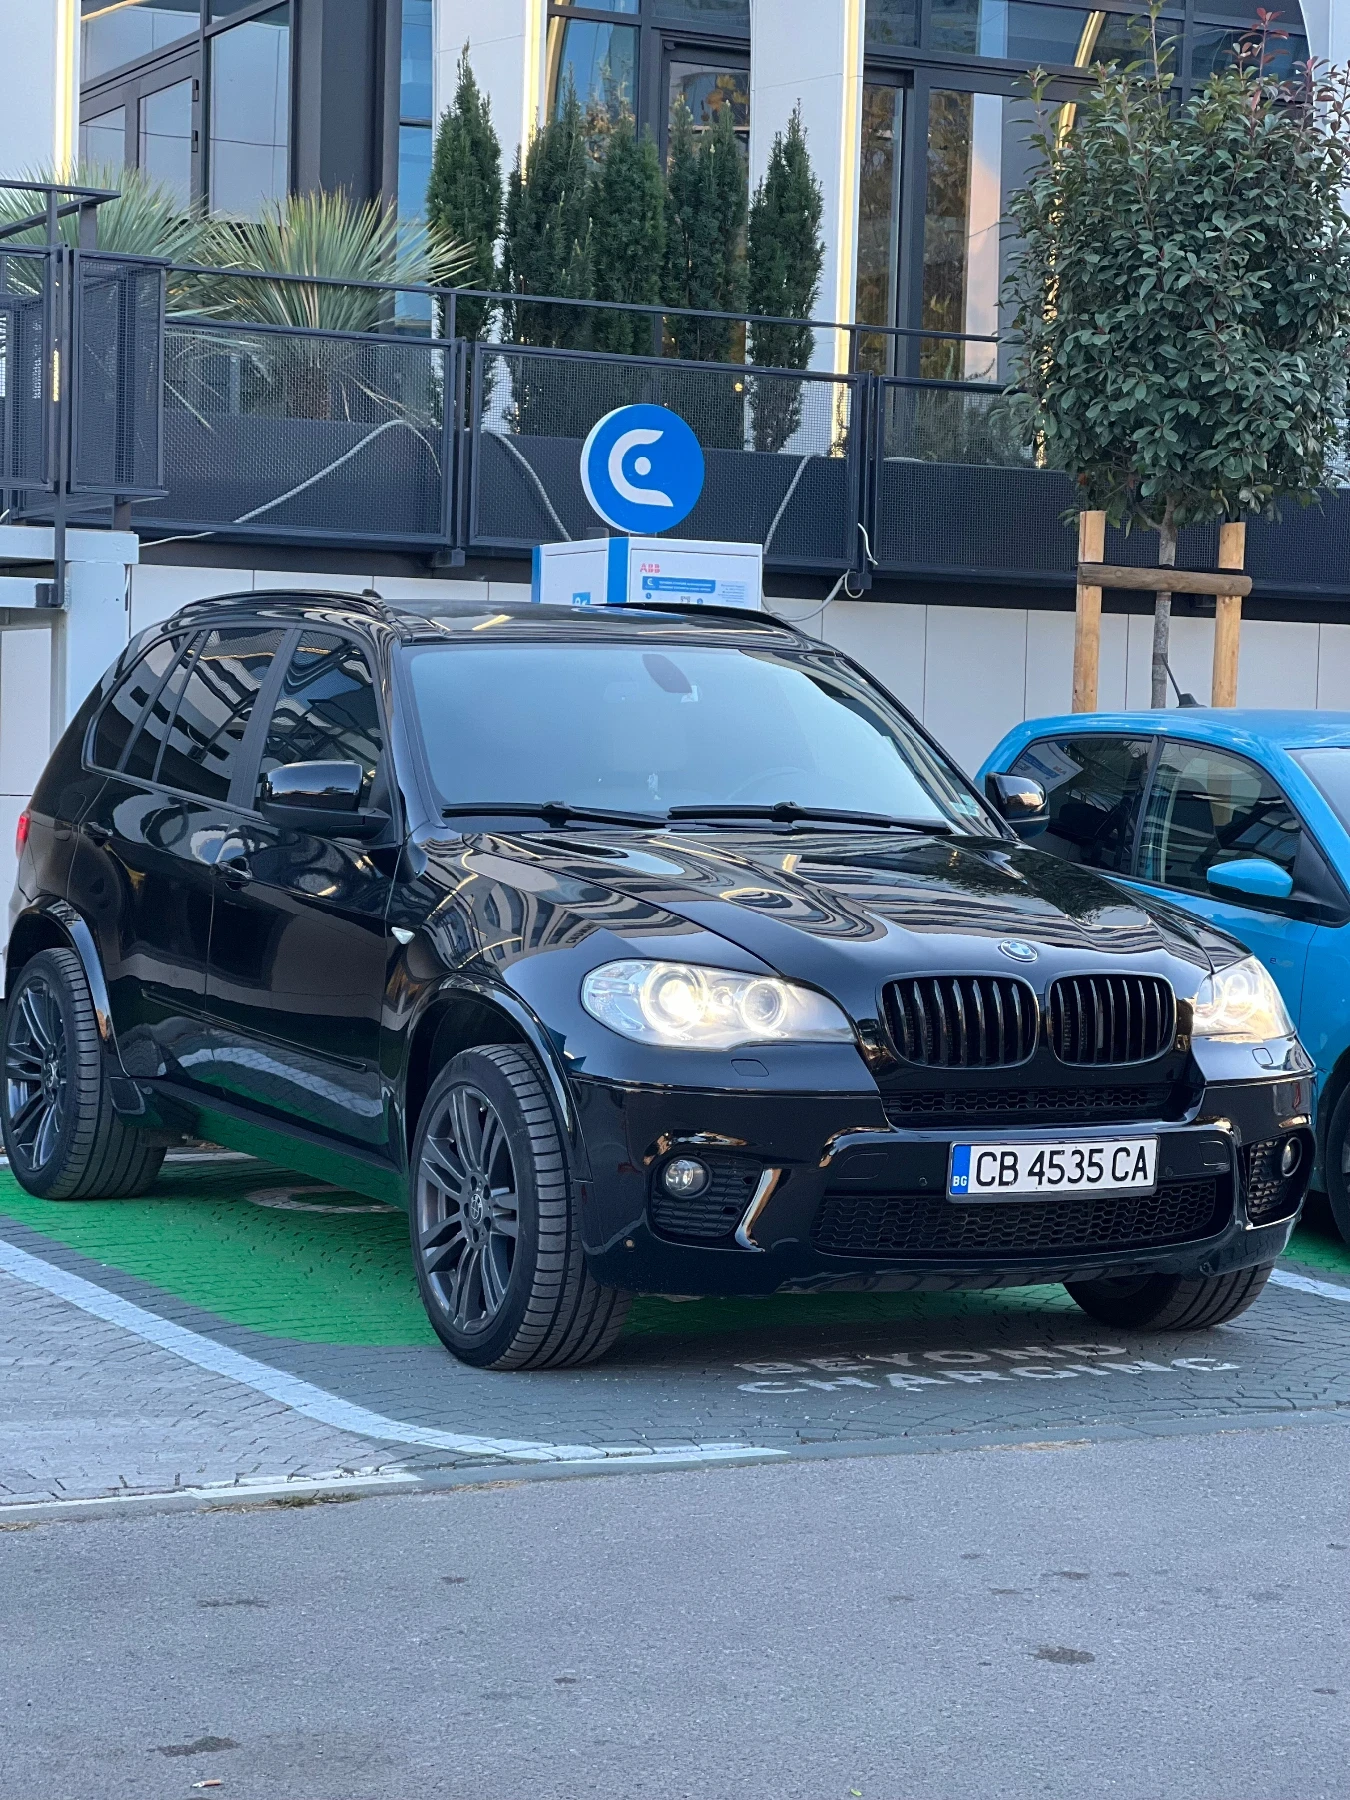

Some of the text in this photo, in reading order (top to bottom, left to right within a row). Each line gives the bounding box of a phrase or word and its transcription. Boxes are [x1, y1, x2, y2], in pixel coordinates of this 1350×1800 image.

[640, 563, 660, 573] ABB
[953, 1175, 968, 1187] BG
[976, 1146, 1149, 1187] CB 4535 CA
[733, 1344, 1127, 1375] BEYOND
[737, 1357, 1241, 1394] CHARGING
